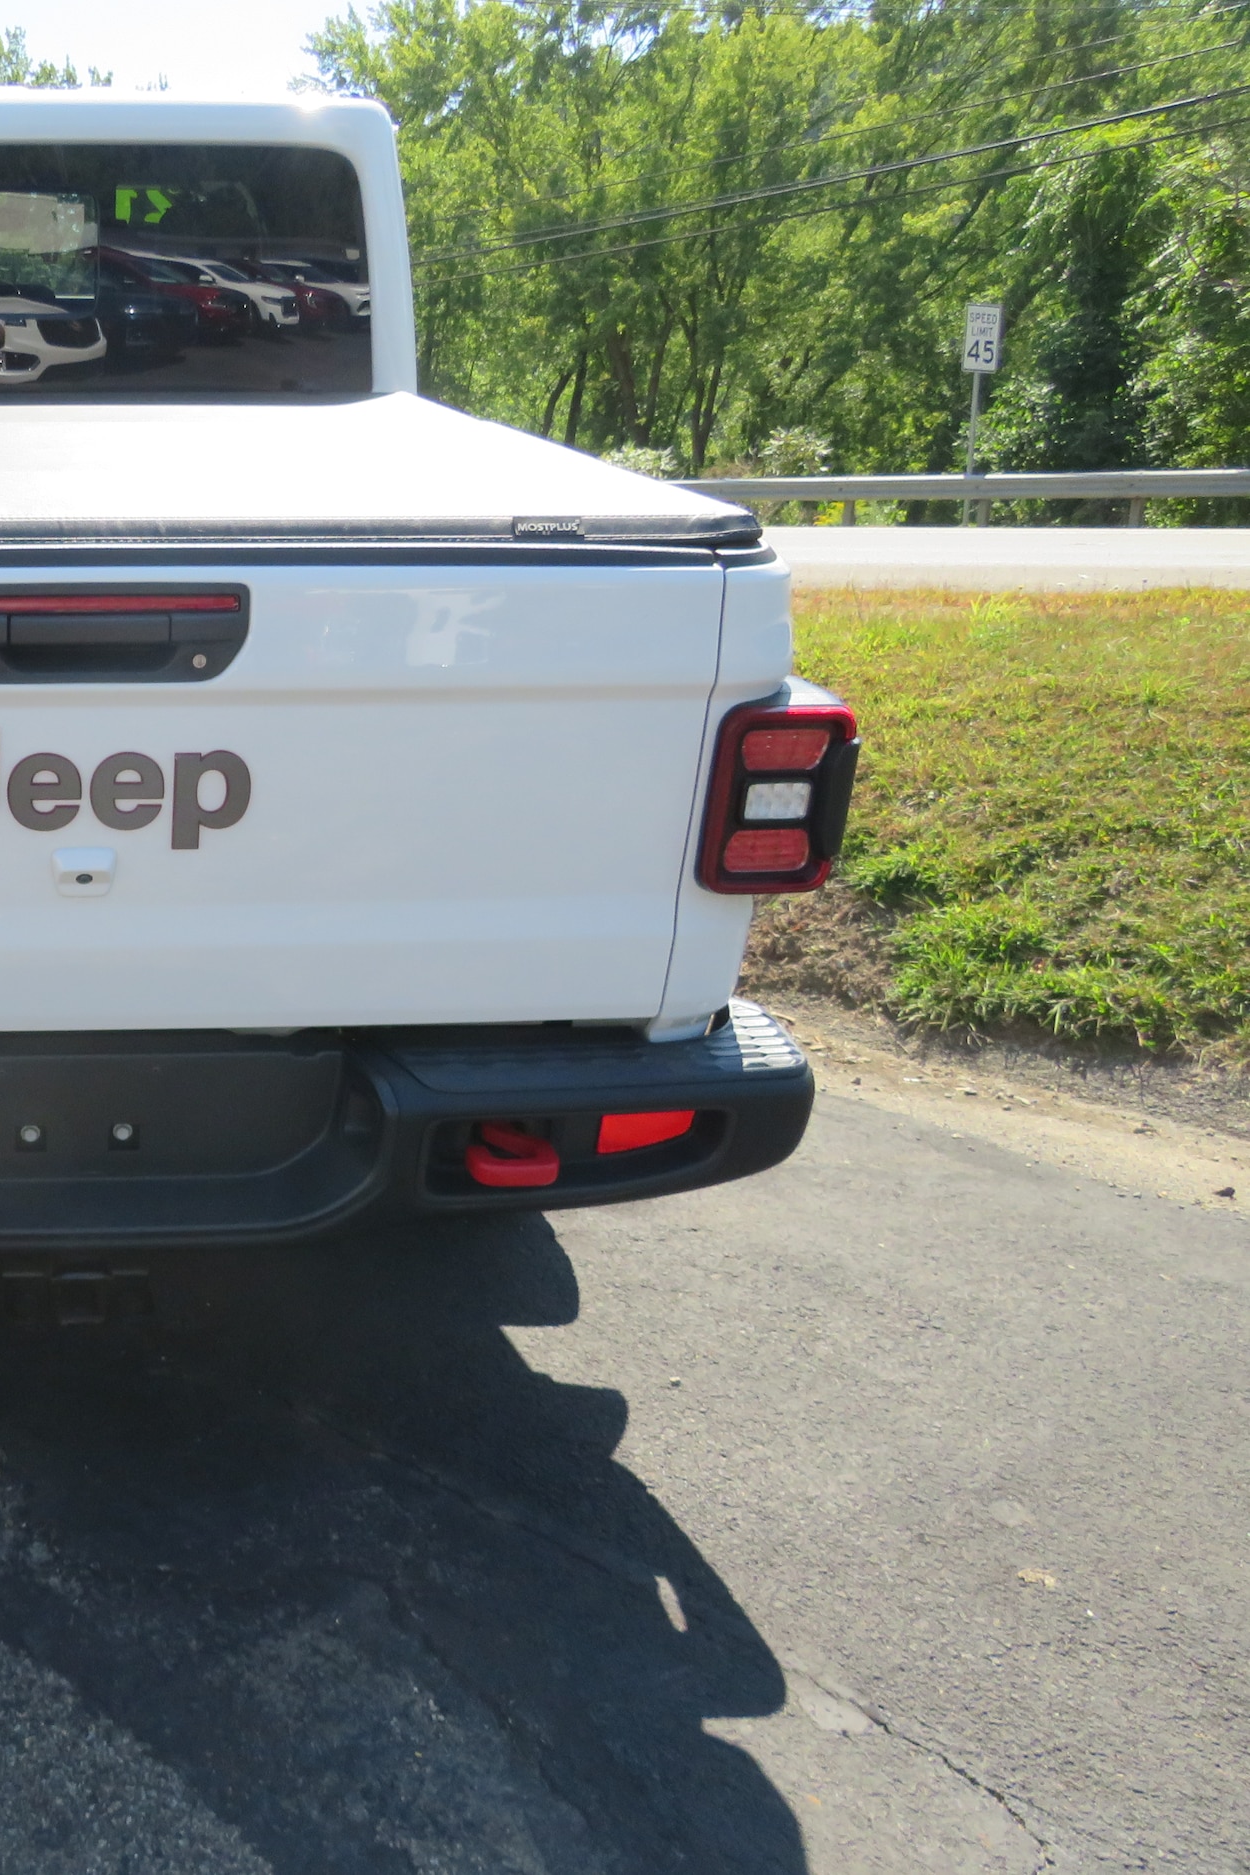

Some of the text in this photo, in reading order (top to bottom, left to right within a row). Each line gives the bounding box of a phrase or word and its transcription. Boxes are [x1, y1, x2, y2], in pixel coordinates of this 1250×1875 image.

[969, 312, 998, 325] SPEED
[971, 326, 994, 337] LIMIT
[967, 339, 995, 364] 45
[517, 522, 579, 532] MOSTPLUS
